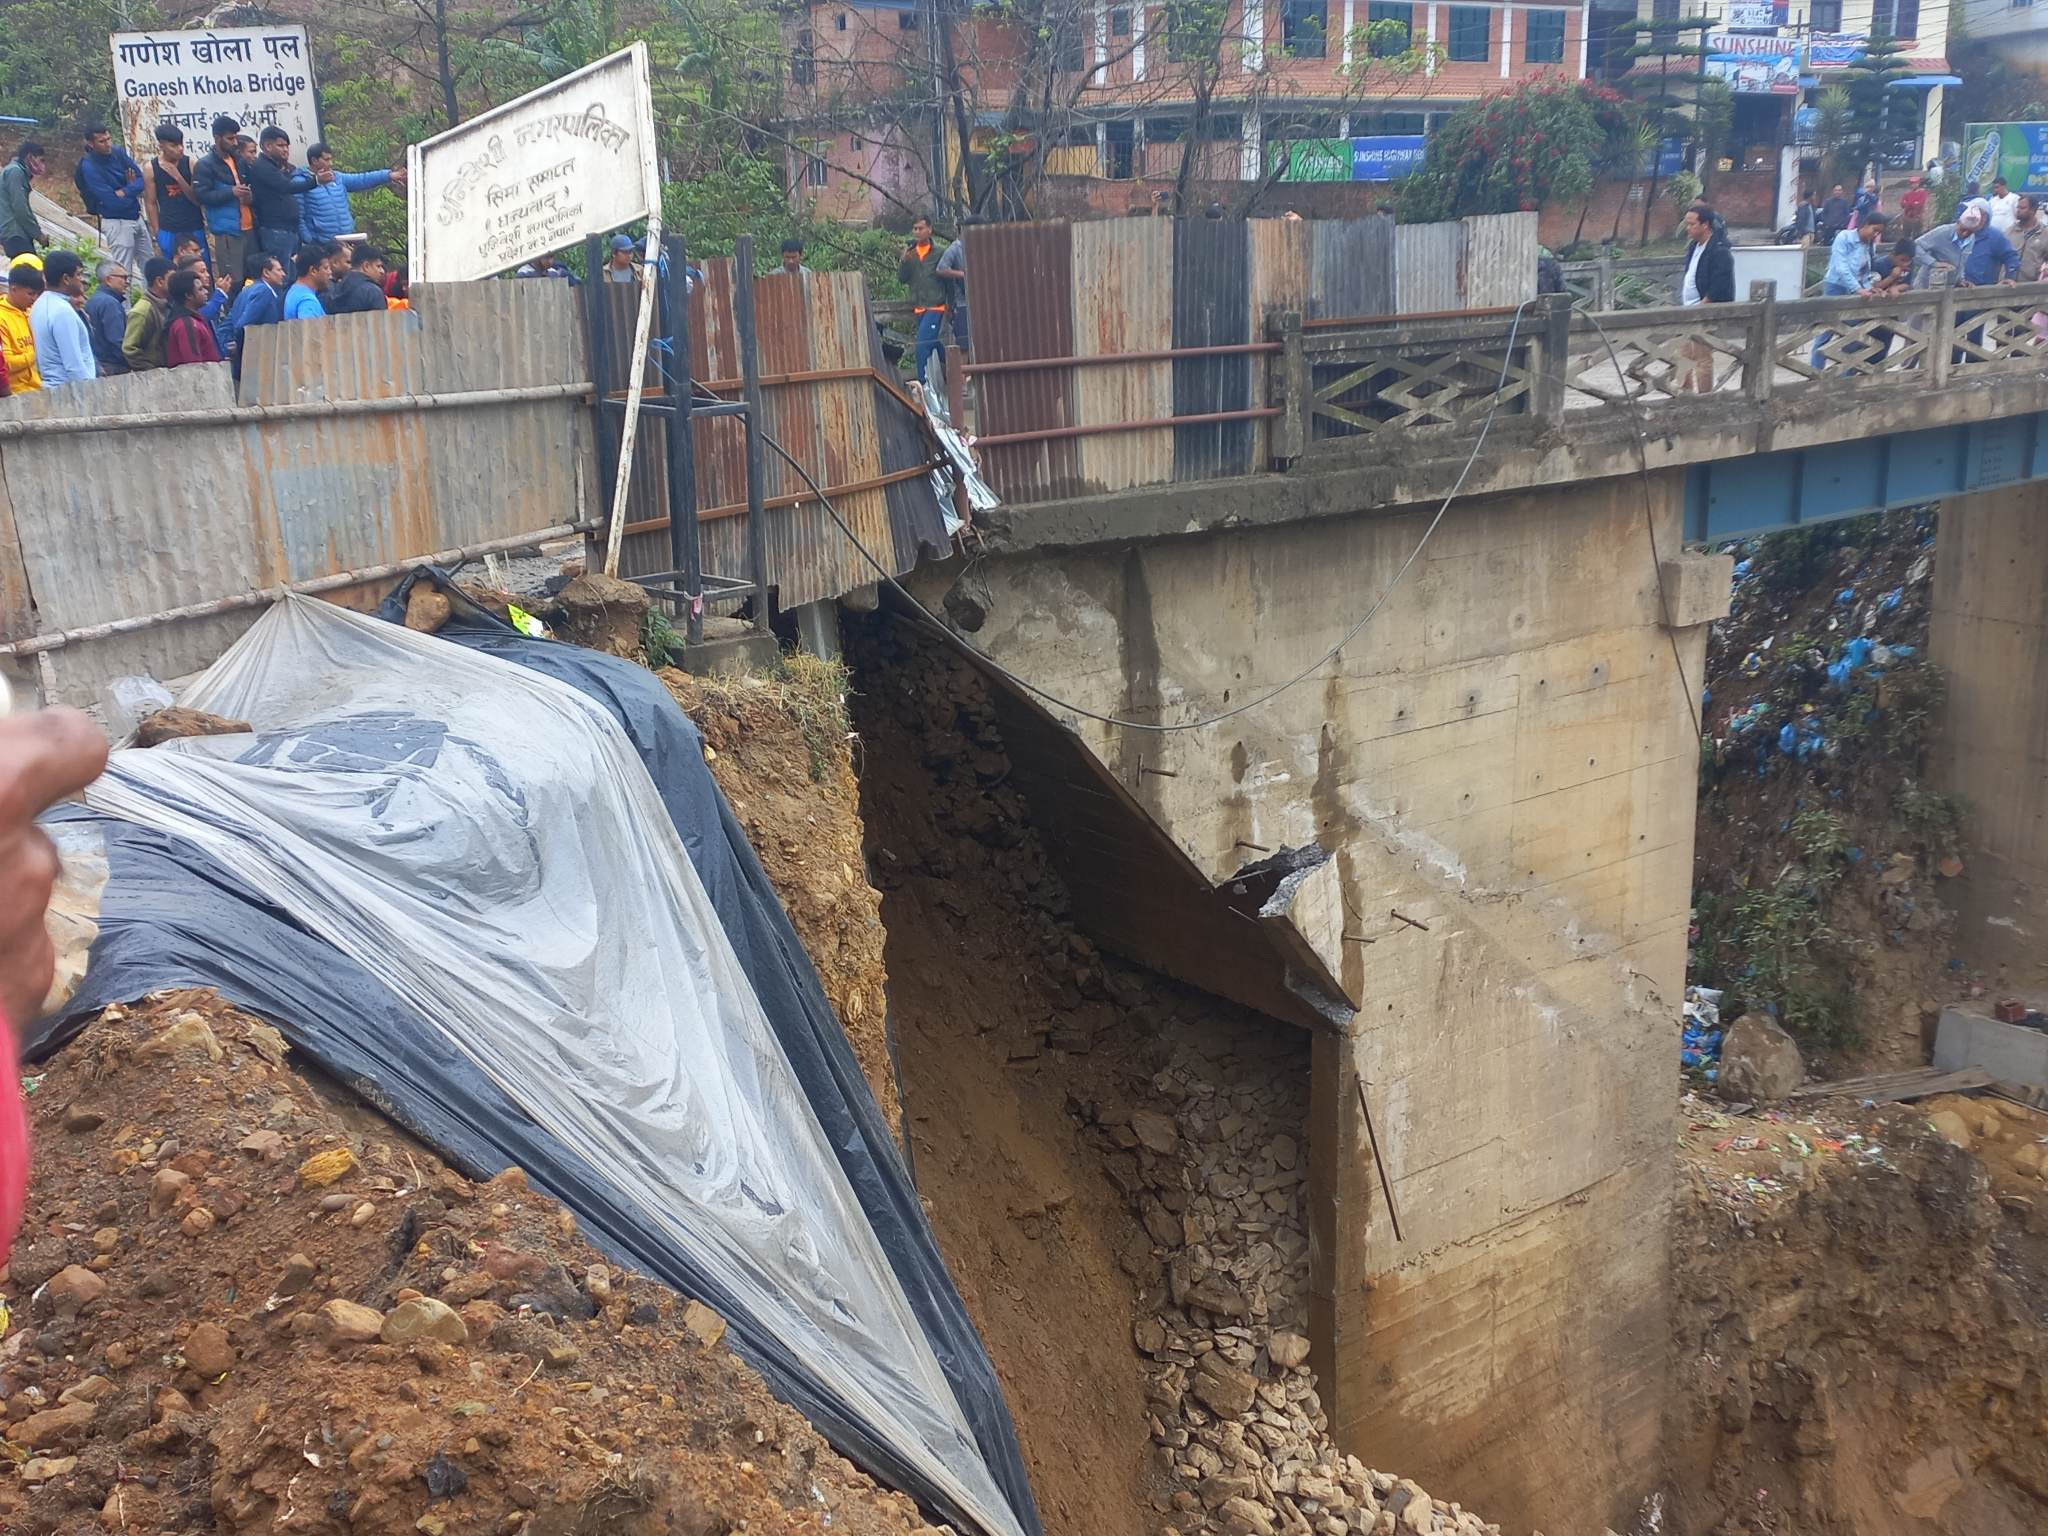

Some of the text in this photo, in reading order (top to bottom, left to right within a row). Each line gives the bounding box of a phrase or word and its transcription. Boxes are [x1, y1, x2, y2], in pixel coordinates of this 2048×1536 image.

[119, 32, 300, 70] गणेश खोला पूल
[1713, 36, 1797, 56] SUNSHINE
[124, 72, 306, 98] Ganesh Khola Bridge
